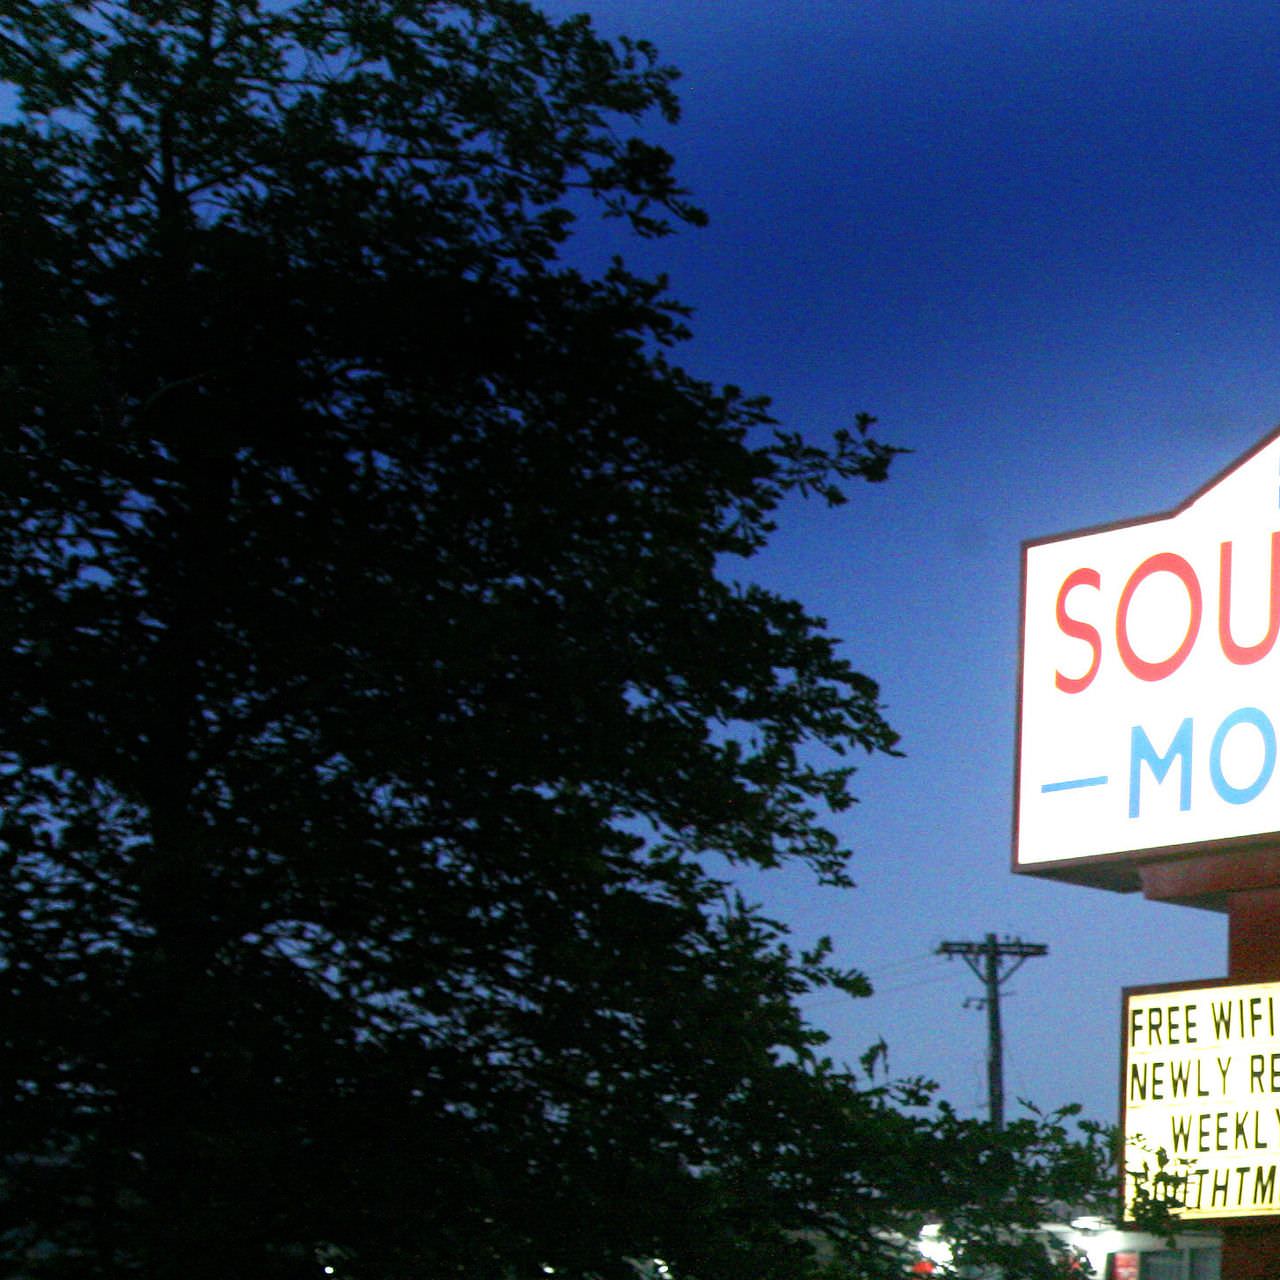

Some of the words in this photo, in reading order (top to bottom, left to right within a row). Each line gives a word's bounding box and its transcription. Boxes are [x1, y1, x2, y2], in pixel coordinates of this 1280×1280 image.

[1131, 1004, 1198, 1048] FREE
[1211, 997, 1275, 1040] WIFI
[1130, 1056, 1232, 1101] NEWLY
